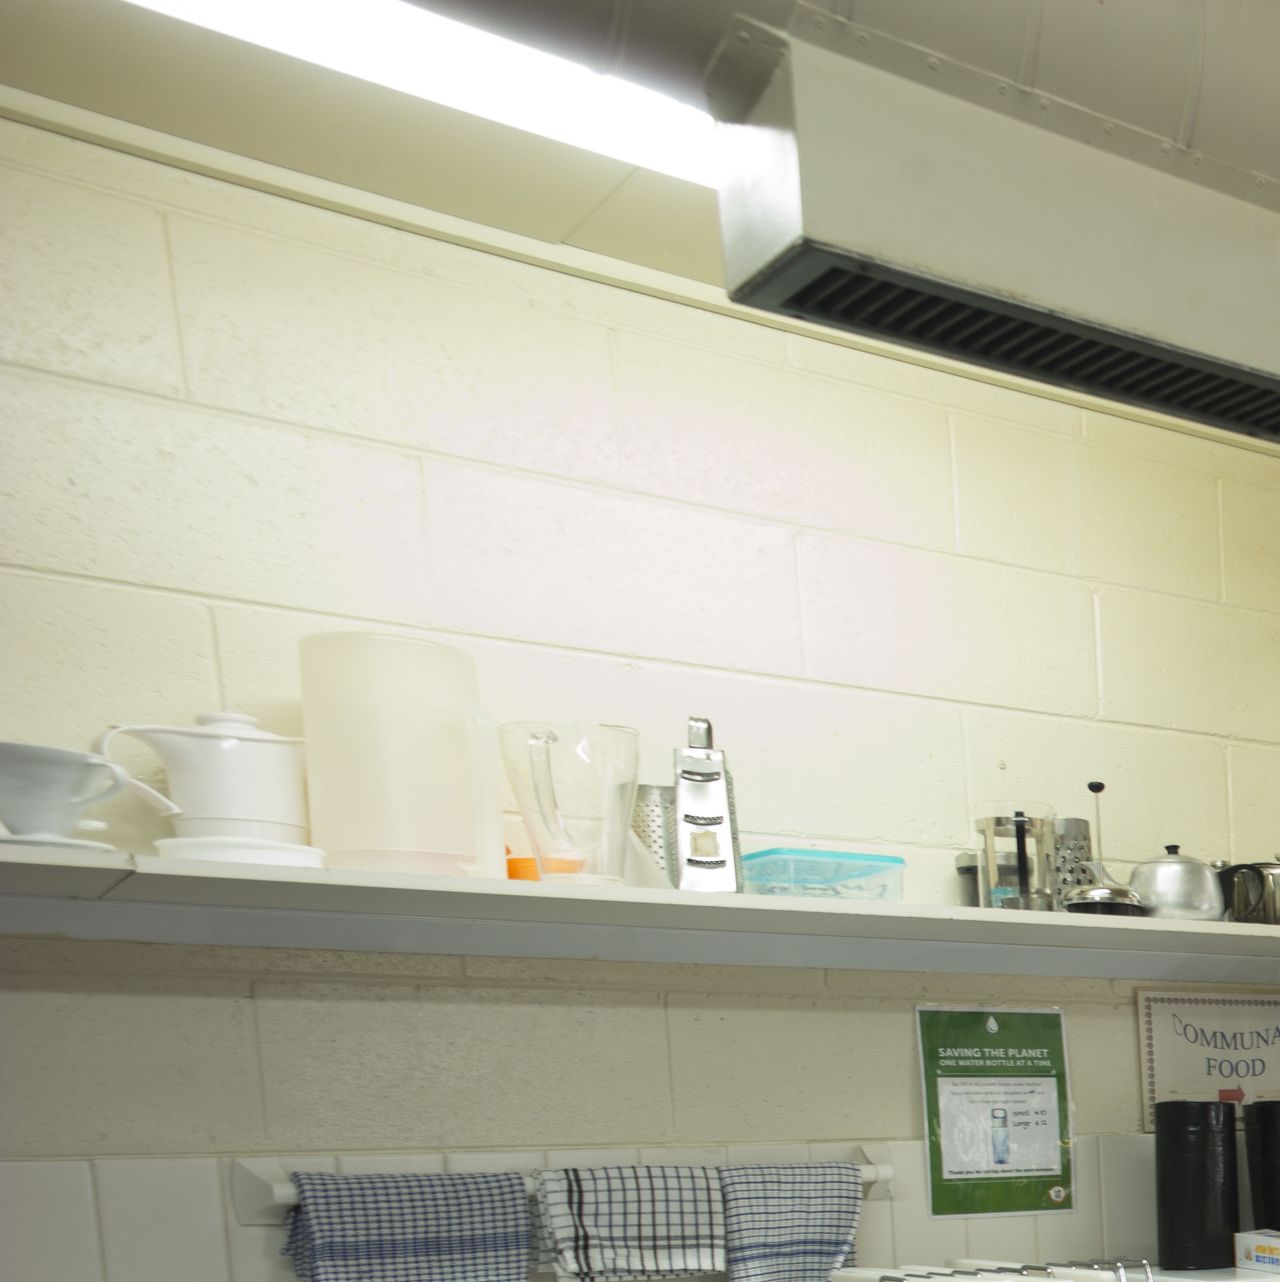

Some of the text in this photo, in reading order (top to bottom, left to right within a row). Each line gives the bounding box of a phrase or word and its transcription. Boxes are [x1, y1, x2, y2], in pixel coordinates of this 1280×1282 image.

[939, 1047, 1049, 1058] SAVING THE PLANET
[959, 1059, 985, 1067] WATER
[1206, 1057, 1266, 1078] FOOD
